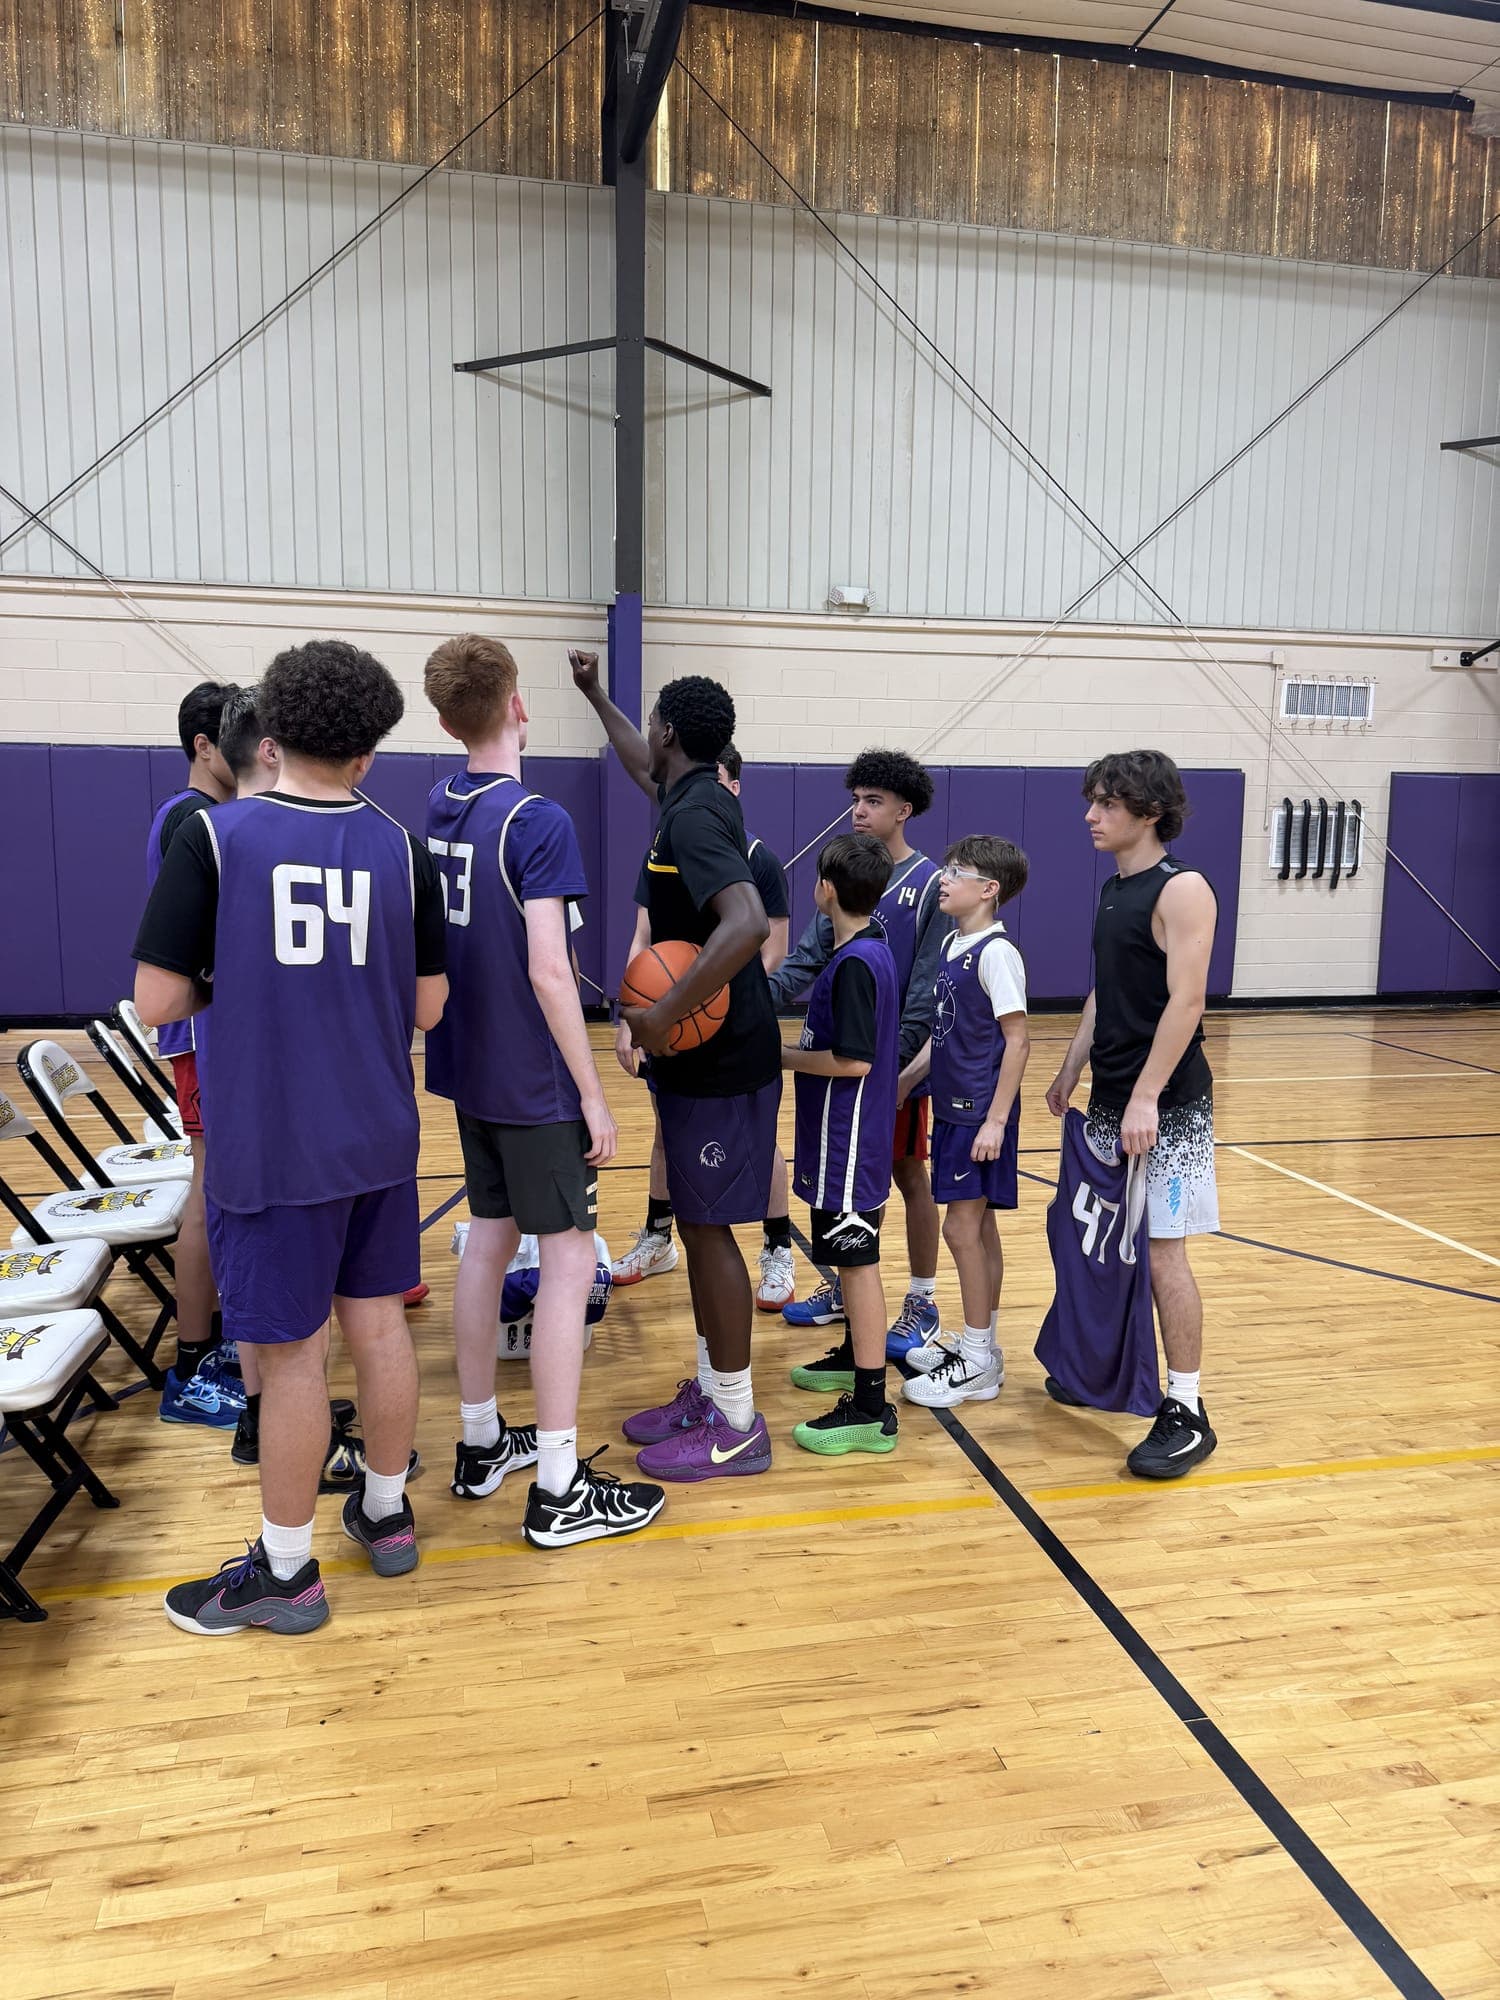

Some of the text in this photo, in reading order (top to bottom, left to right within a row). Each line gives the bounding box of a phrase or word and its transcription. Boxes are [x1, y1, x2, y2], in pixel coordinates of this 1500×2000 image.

[272, 864, 371, 966] 64
[897, 886, 917, 907] 14
[962, 953, 973, 970] 2
[1072, 1181, 1120, 1264] 47
